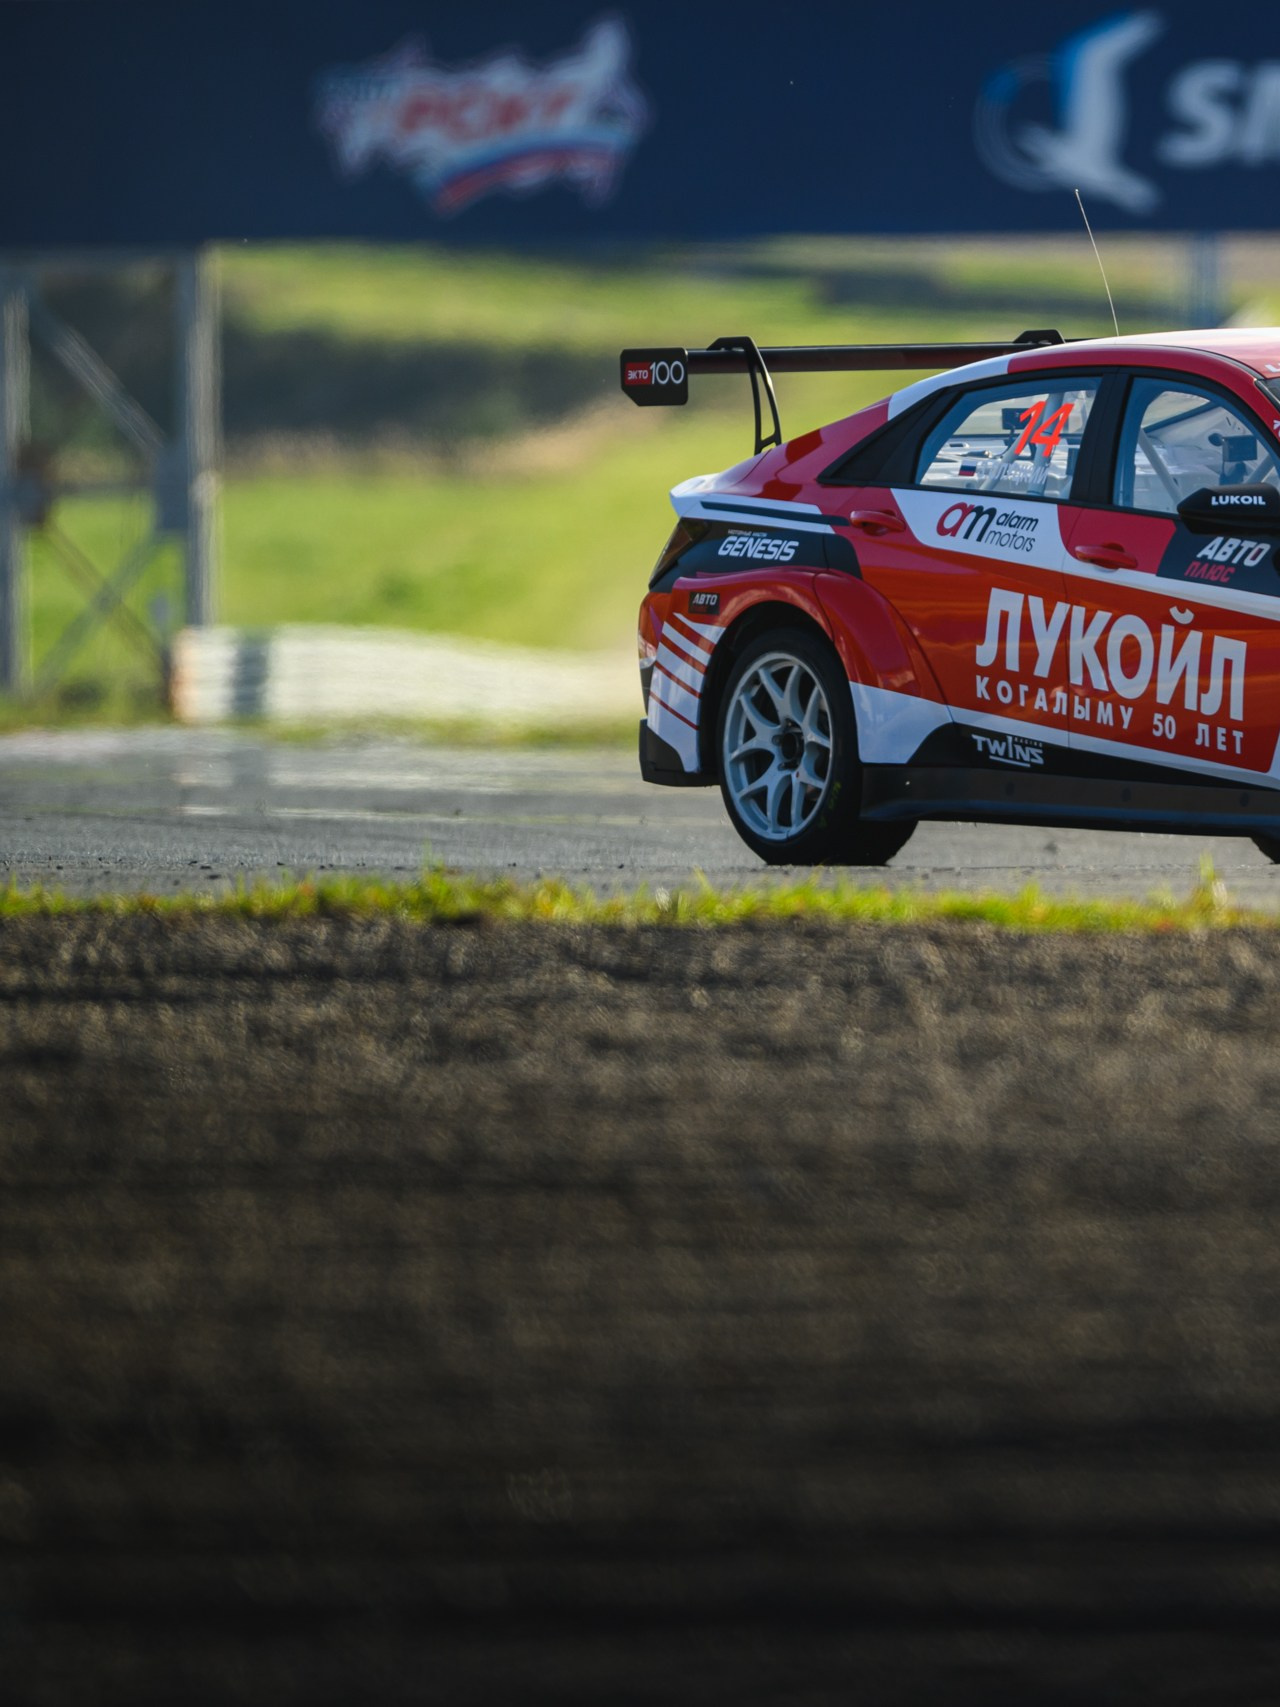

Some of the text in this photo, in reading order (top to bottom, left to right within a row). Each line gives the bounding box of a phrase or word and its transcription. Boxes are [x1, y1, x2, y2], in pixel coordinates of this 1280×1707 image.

[1014, 401, 1074, 458] 14
[1211, 495, 1267, 506] LUKOIL
[995, 510, 1039, 532] alarm
[718, 535, 800, 561] GENESIS
[984, 530, 1036, 553] motors
[1196, 536, 1271, 567] АВТО
[1184, 561, 1236, 583] ПЛЮС
[692, 593, 718, 606] АВТО
[975, 586, 1248, 722] ЛУКОЙЛ
[975, 674, 1245, 755] КОГАЛЫМУ 50 ЛЕТ
[971, 733, 1045, 765] TWINS
